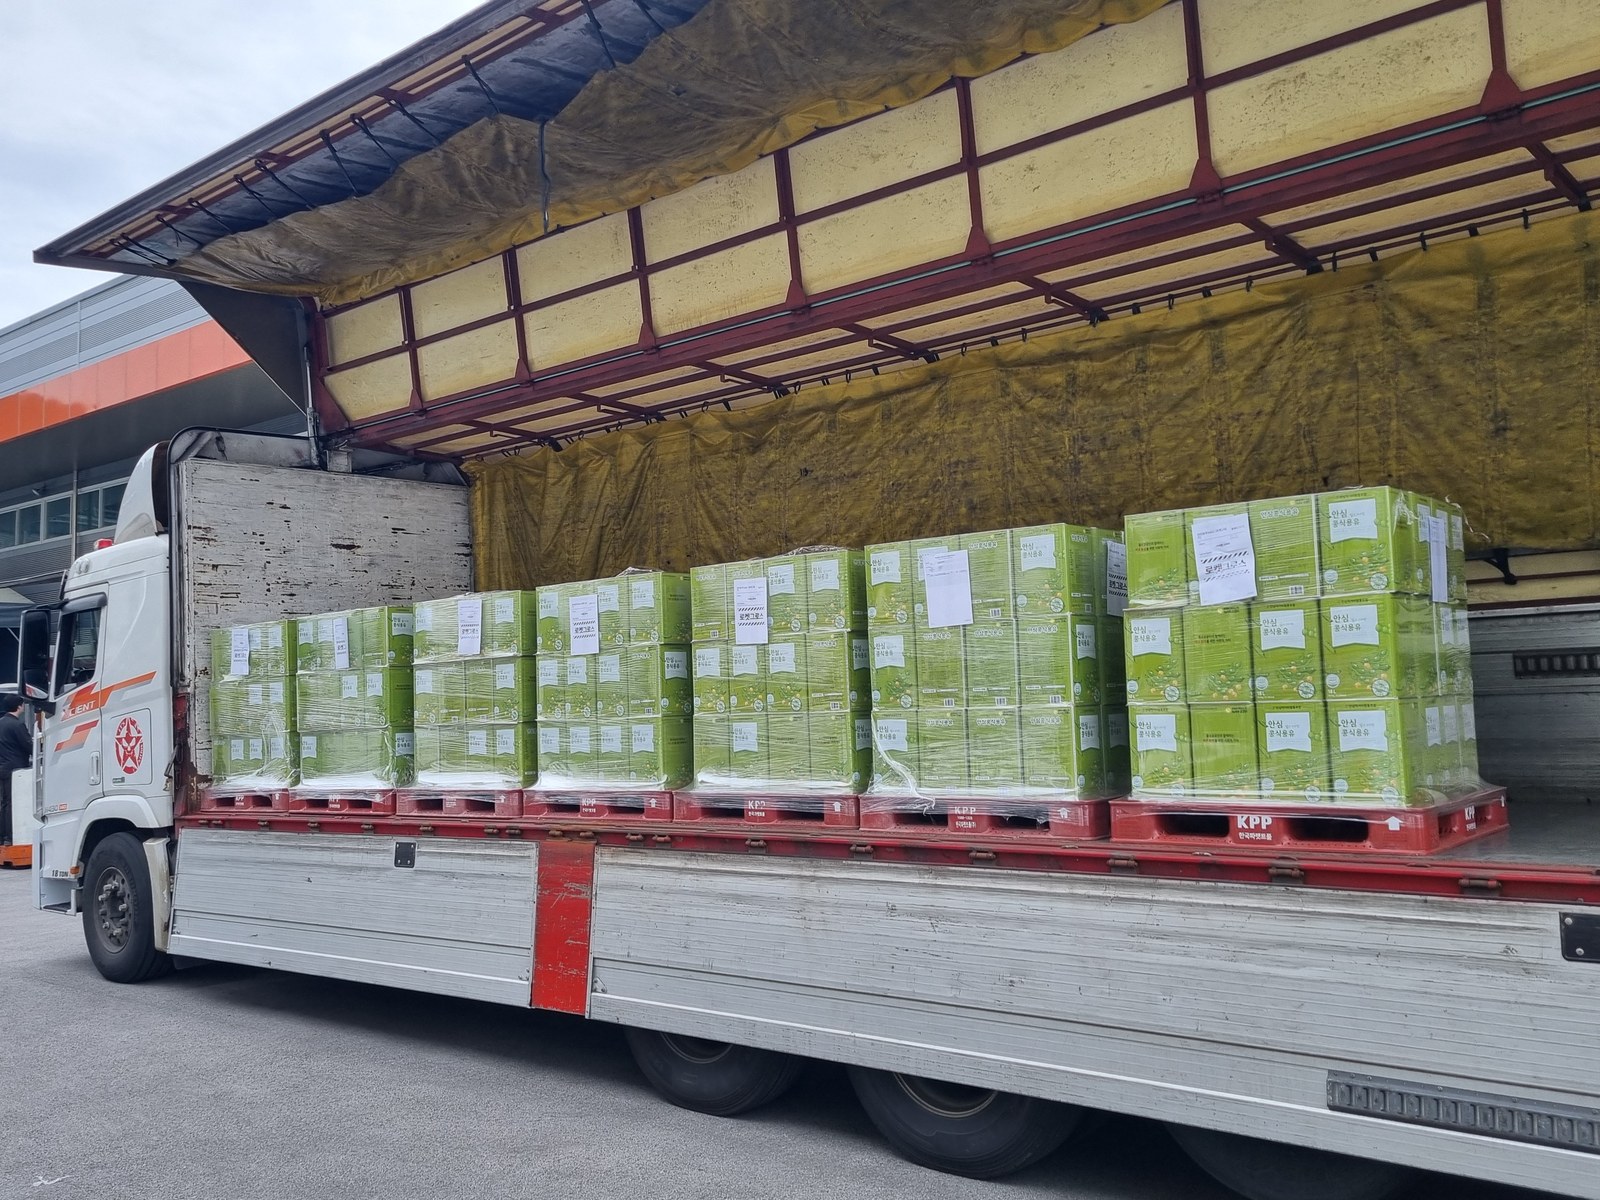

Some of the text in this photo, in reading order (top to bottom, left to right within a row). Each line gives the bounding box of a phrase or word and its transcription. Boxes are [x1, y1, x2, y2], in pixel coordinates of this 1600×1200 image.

[1331, 509, 1348, 519] 안심
[1262, 618, 1277, 627] 안심
[1333, 614, 1349, 623] 안심
[1268, 720, 1283, 729] 안심
[1340, 719, 1357, 728] 안심
[955, 806, 976, 815] KPP
[1237, 815, 1273, 829] KPP
